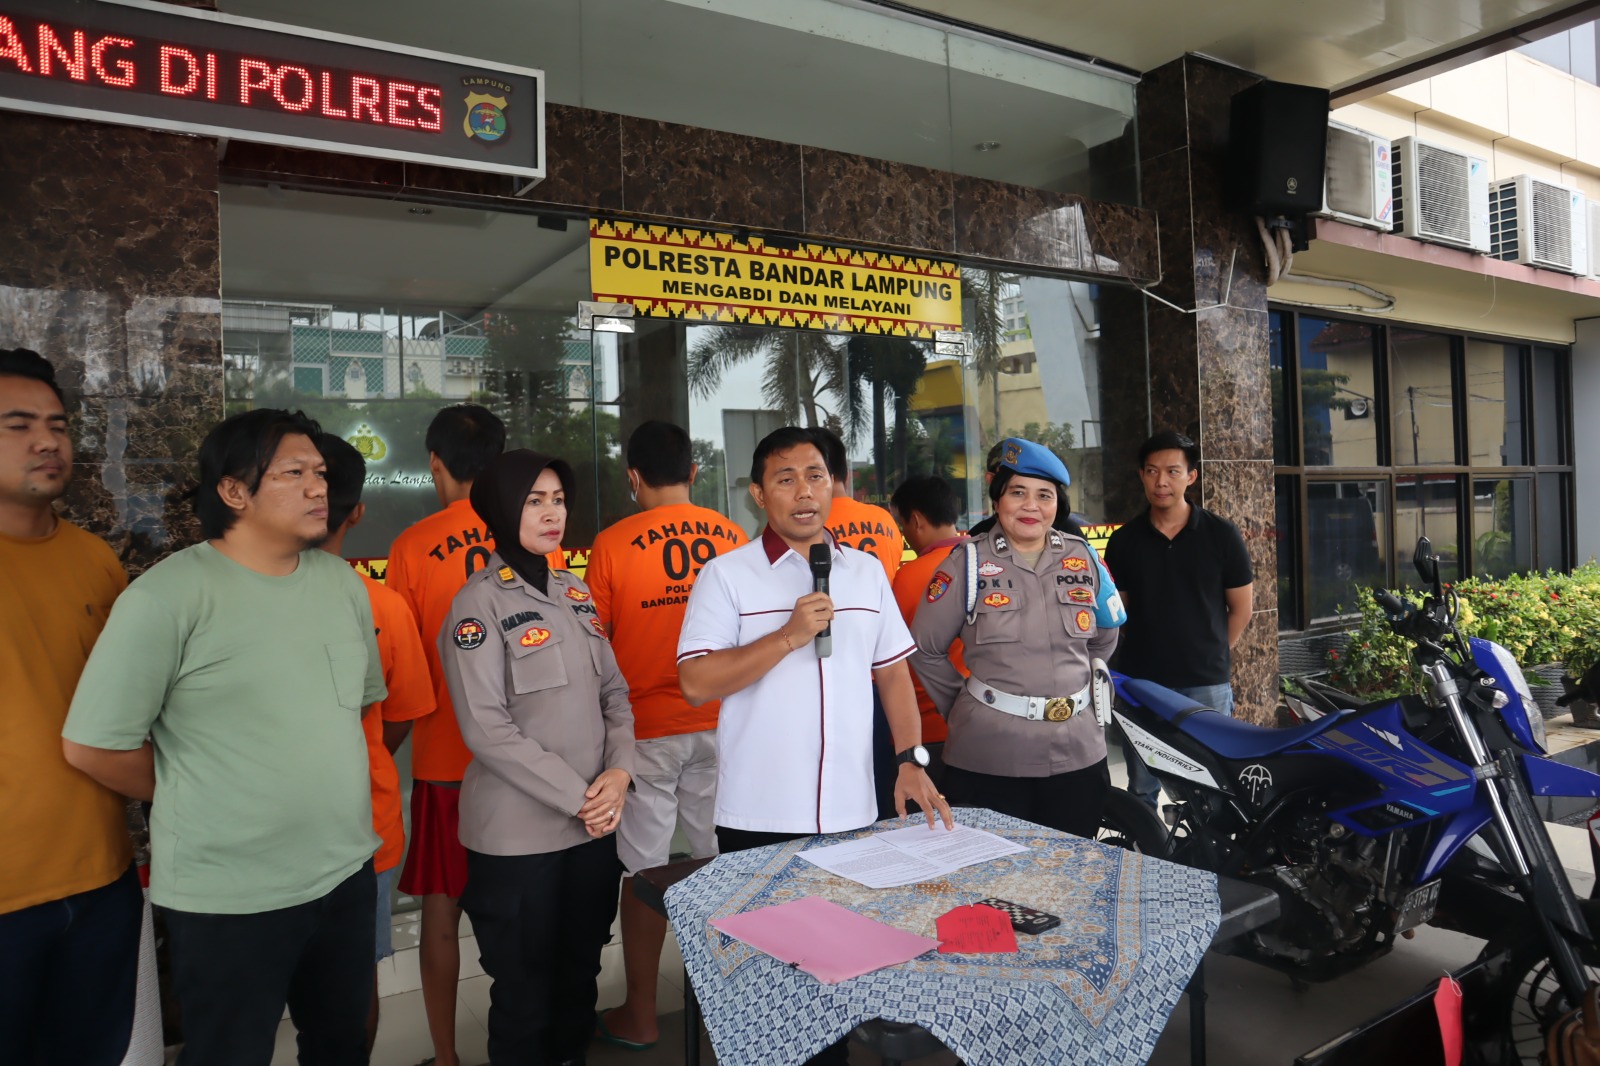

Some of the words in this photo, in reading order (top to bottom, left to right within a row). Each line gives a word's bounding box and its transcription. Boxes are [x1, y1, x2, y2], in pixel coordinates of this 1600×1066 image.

[160, 45, 216, 99] DI
[240, 58, 441, 131] POLRES
[463, 78, 511, 92] LAMPUNG
[604, 245, 742, 279] POLRESTA
[749, 260, 844, 289] BANDAR
[851, 272, 952, 301] LAMPUNG
[662, 280, 772, 302] MENGABDI
[779, 290, 817, 306] DAN
[824, 295, 911, 315] MELAYANI
[631, 521, 737, 550] TAHANAN
[838, 537, 878, 559] 6
[662, 538, 716, 580] 09
[1056, 575, 1093, 586] POLRI
[1134, 740, 1154, 752] STARK
[1154, 750, 1194, 771] INDUSTRIES
[1386, 803, 1414, 820] YAMAHA
